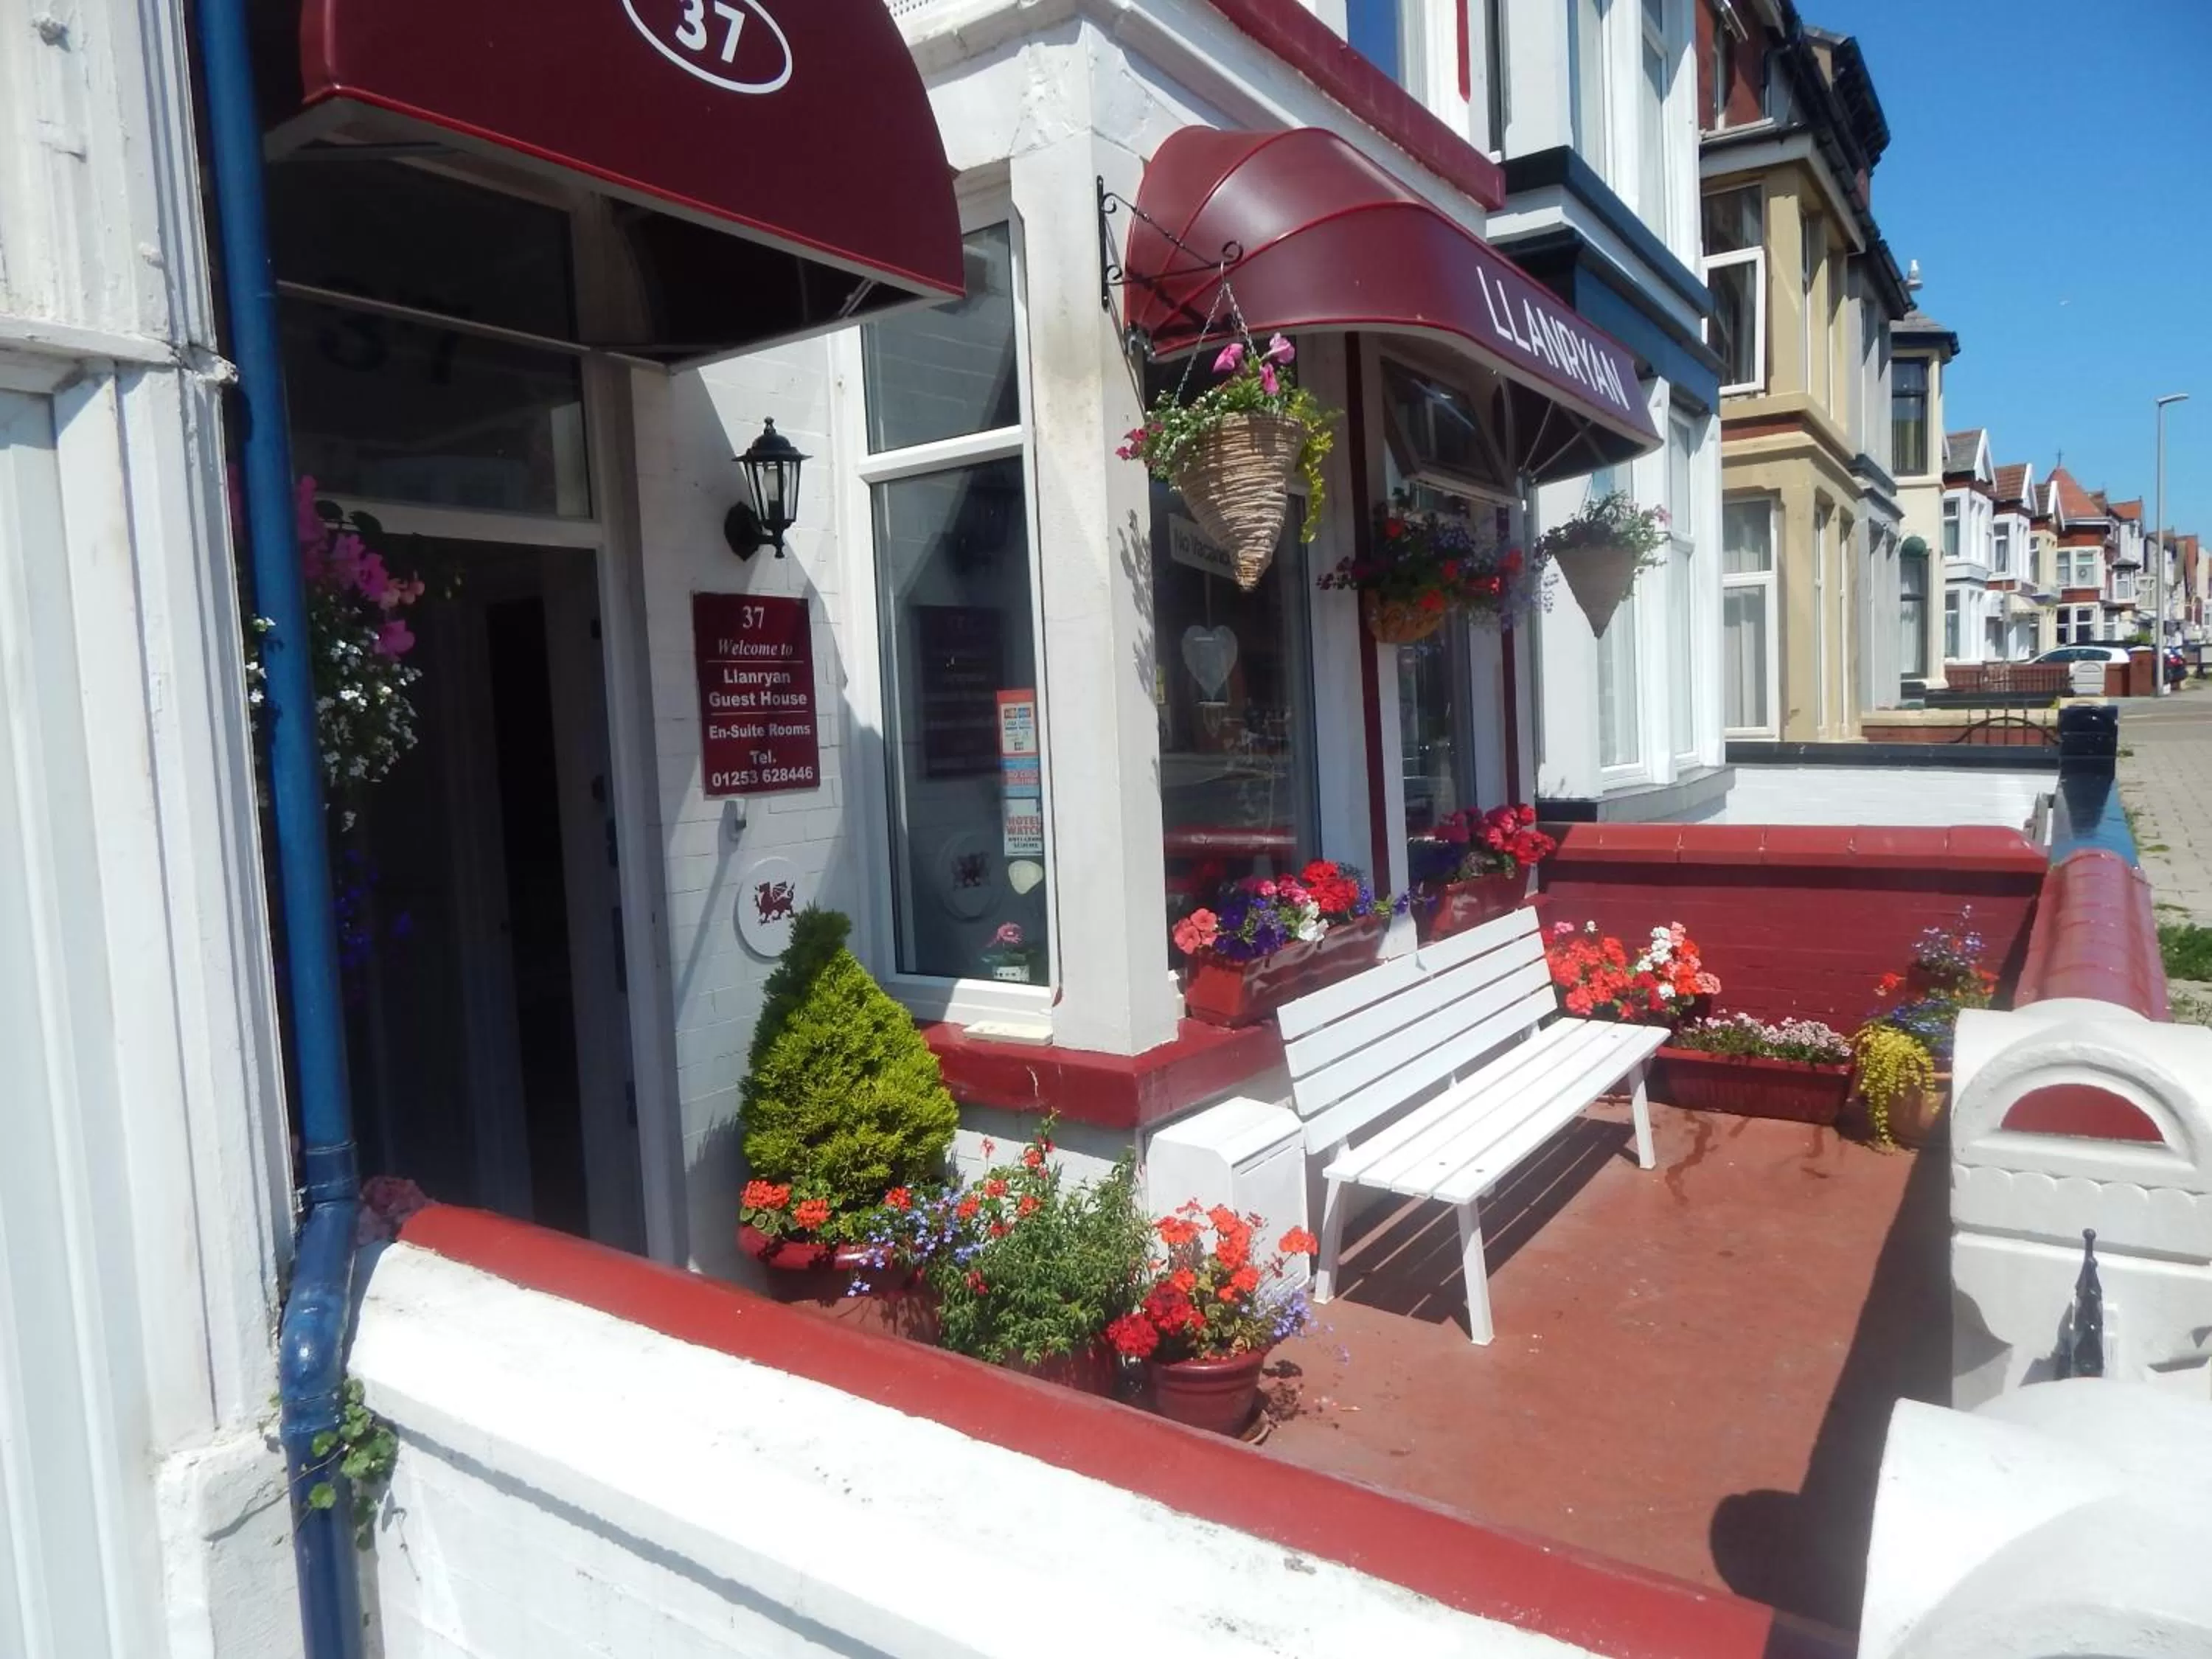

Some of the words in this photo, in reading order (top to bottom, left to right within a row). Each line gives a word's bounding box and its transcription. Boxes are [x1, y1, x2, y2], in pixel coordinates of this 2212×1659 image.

[675, 0, 745, 63] 37
[1475, 265, 1631, 411] LLANRYAN
[742, 605, 765, 629] 37
[718, 638, 778, 655] Welcome
[781, 643, 793, 655] to
[723, 669, 791, 687] Llanryan
[709, 692, 756, 707] Guest
[760, 692, 808, 706] House
[709, 723, 765, 740] En-Suite
[769, 723, 811, 736] Rooms
[749, 749, 776, 765] Tel.
[712, 771, 759, 787] 01253
[762, 766, 813, 783] 628446
[1008, 815, 1040, 825] HOTEL
